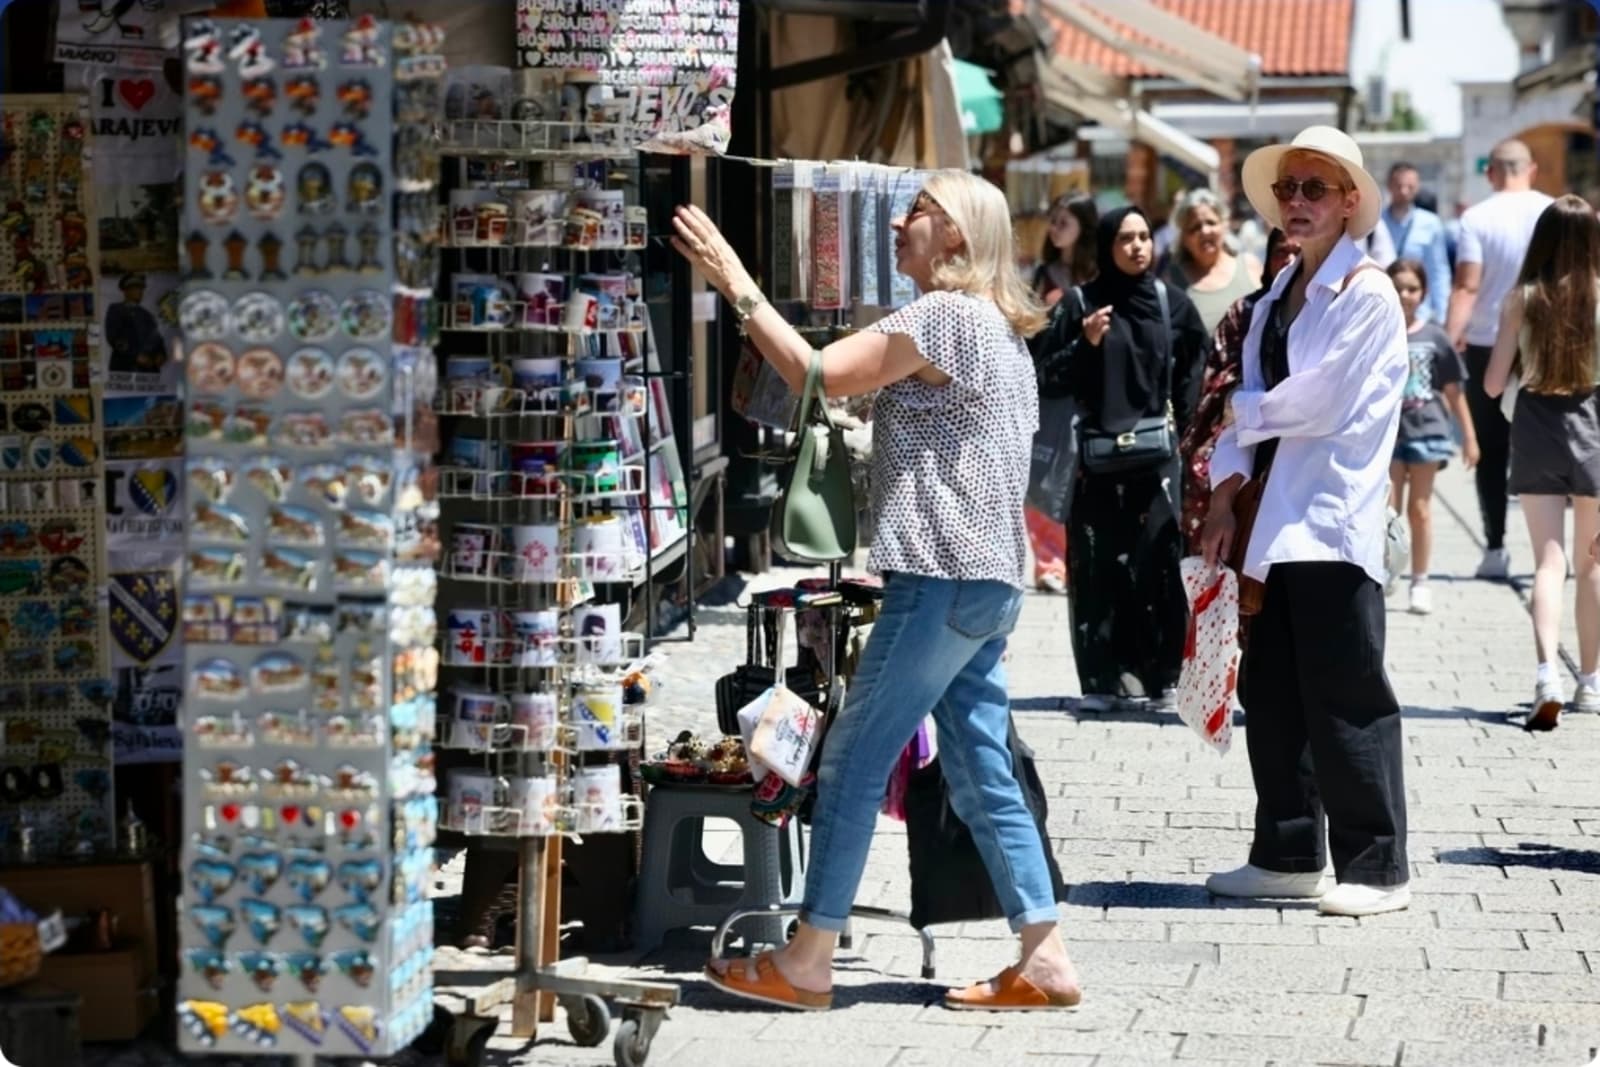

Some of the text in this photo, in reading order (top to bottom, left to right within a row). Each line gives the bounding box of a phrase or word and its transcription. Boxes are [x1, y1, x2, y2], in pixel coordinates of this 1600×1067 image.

[543, 51, 608, 66] SARAJEVO
[601, 71, 674, 86] RCEGOVINA
[91, 117, 180, 140] RAJEV
